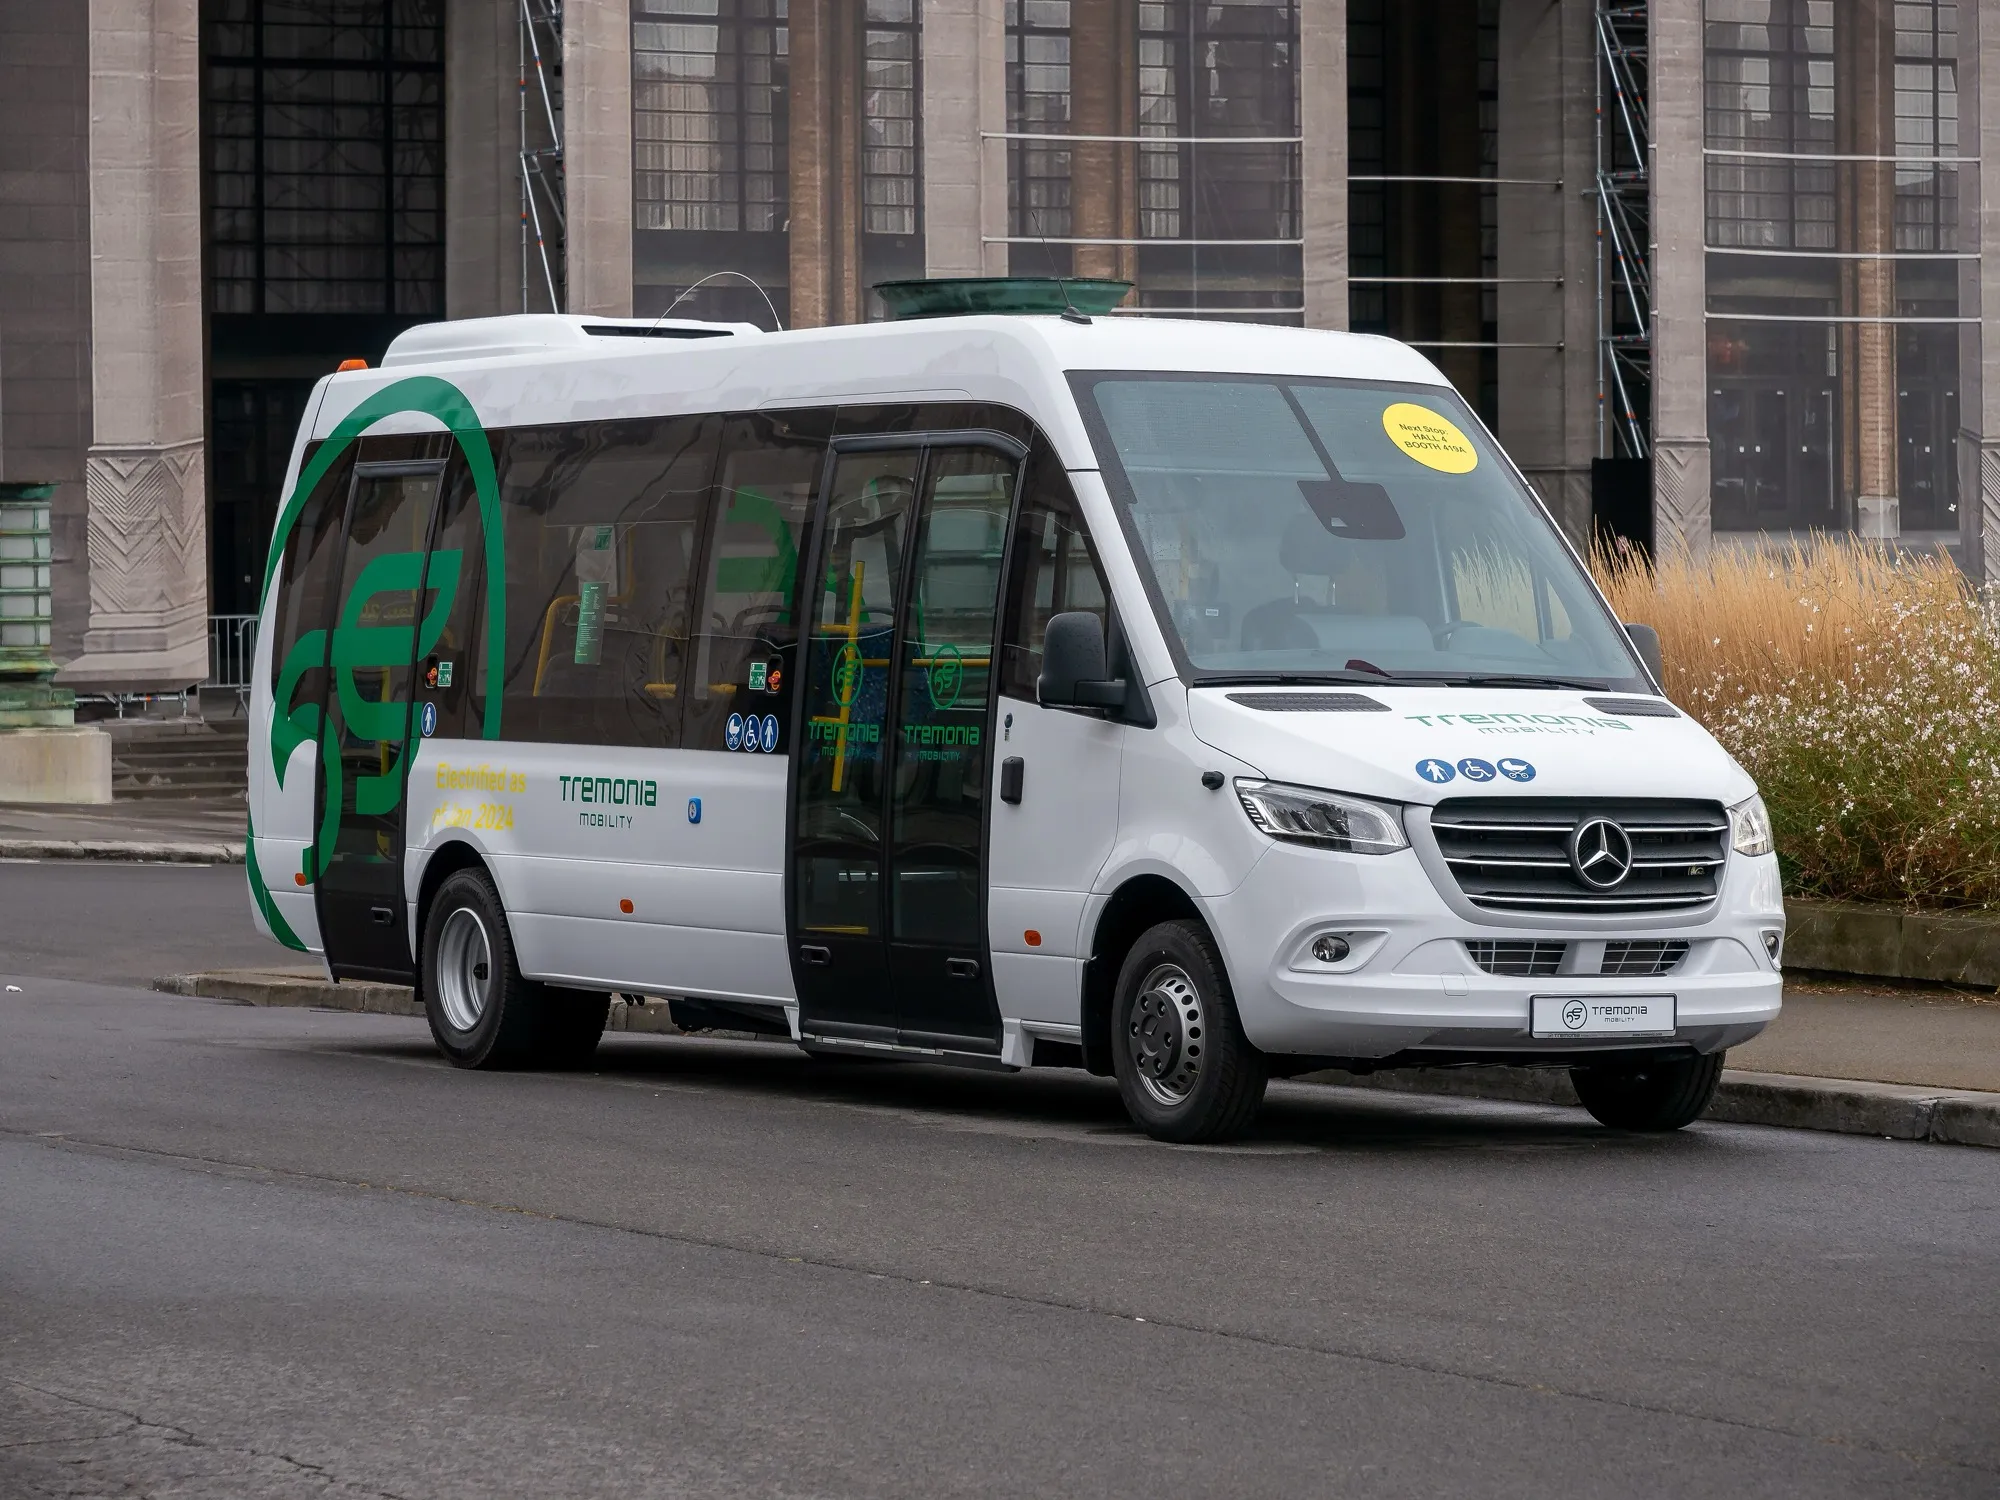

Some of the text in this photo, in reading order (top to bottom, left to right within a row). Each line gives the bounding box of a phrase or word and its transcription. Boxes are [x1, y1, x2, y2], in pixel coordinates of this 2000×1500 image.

[1399, 423, 1448, 435] Next Stop:
[1412, 433, 1440, 442] HALL
[1404, 441, 1467, 454] BOOTH 419A
[1477, 726, 1595, 736] MOBILITY
[436, 762, 527, 793] Electrified as
[432, 800, 514, 831] of Jan 2024
[579, 812, 633, 829] MOBILITY
